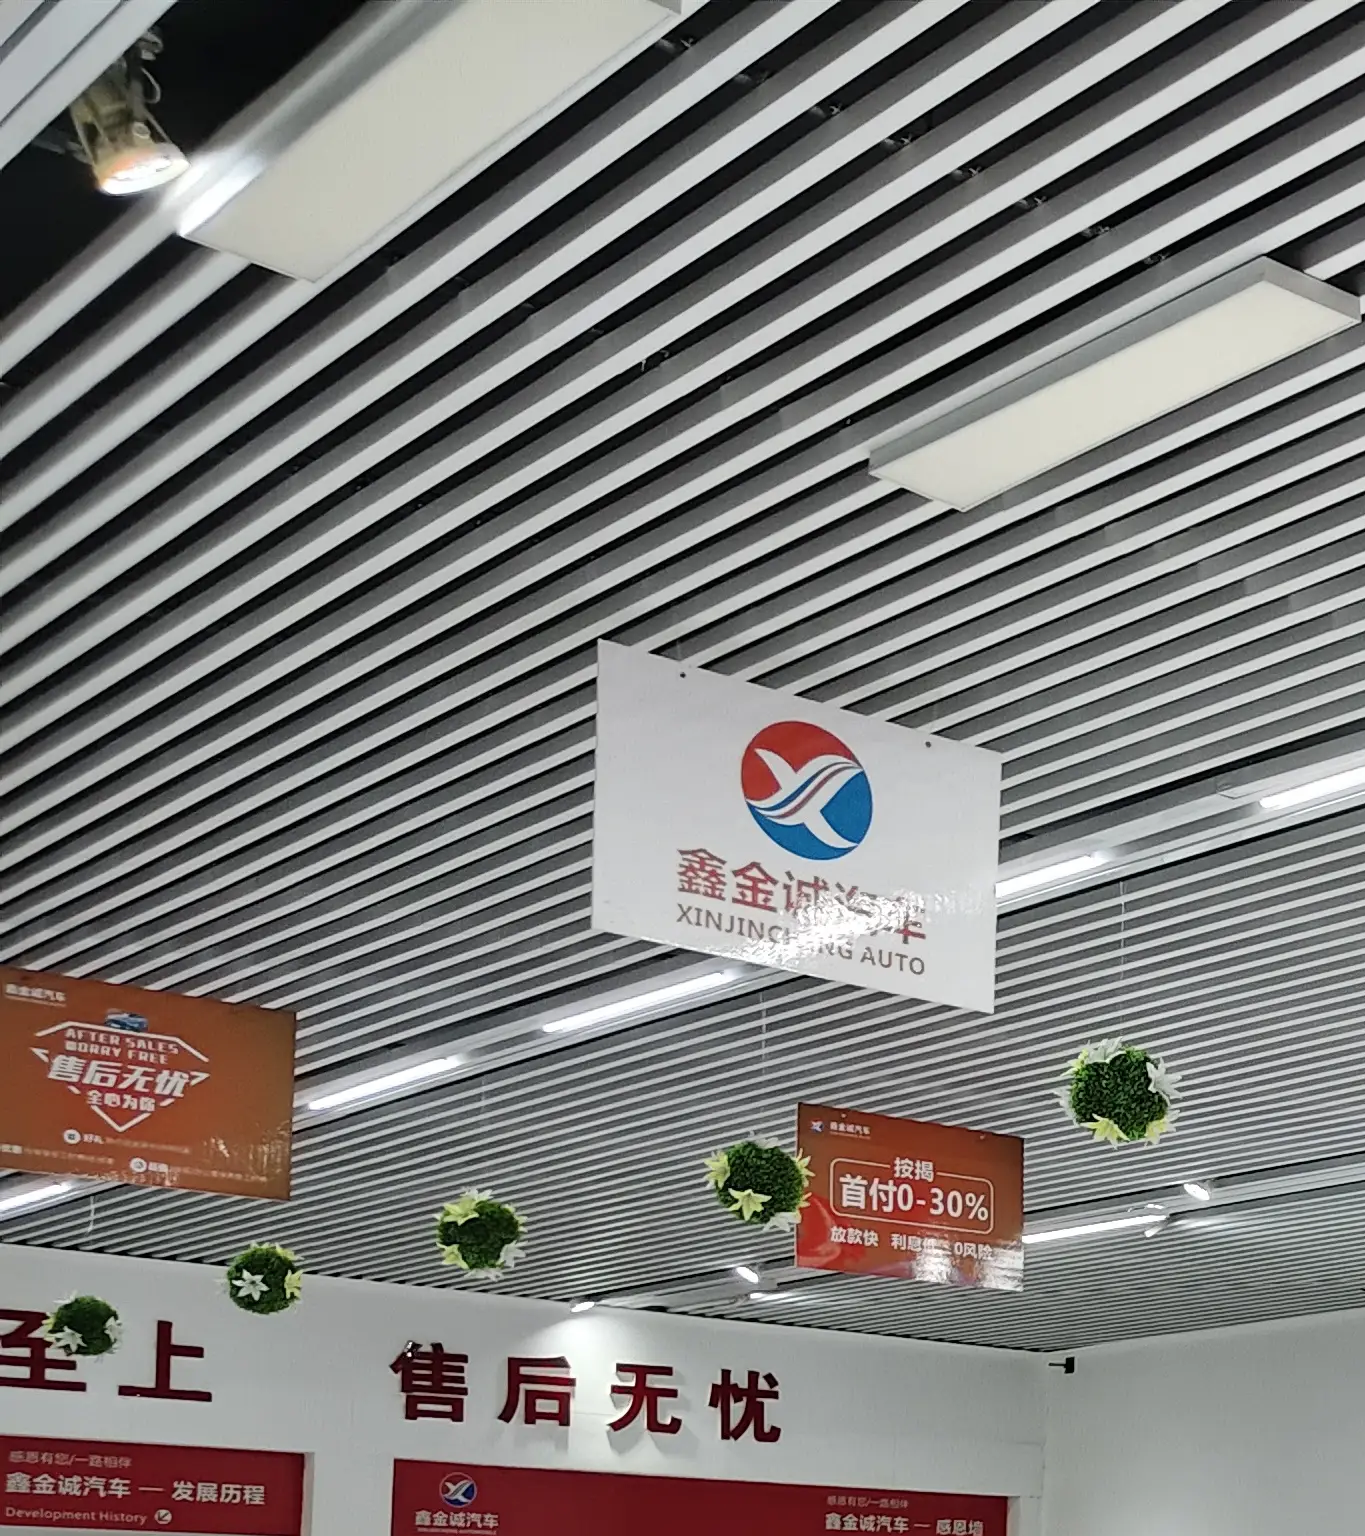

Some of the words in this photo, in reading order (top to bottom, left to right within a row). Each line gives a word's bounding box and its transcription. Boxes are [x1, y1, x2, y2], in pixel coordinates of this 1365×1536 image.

[860, 946, 925, 975] AUTO
[65, 1027, 121, 1046] AFTER
[125, 1037, 180, 1055] SALES
[65, 1040, 121, 1058] WORRY
[127, 1050, 169, 1065] FREE
[48, 1054, 190, 1098] 售后无忧
[893, 1156, 935, 1183] 按揭
[839, 1173, 989, 1221] 首付0-30%
[830, 1226, 880, 1248] 放款快
[0, 1308, 212, 1403] 至上
[389, 1341, 783, 1444] 售后无忧
[5, 1471, 132, 1499] 鑫金诚汽车
[171, 1480, 266, 1505] 发展历程
[5, 1506, 96, 1522] Development
[99, 1511, 148, 1526] History
[415, 1509, 499, 1529] 鑫金诚汽车
[825, 1512, 910, 1534] 鑫金诚汽车
